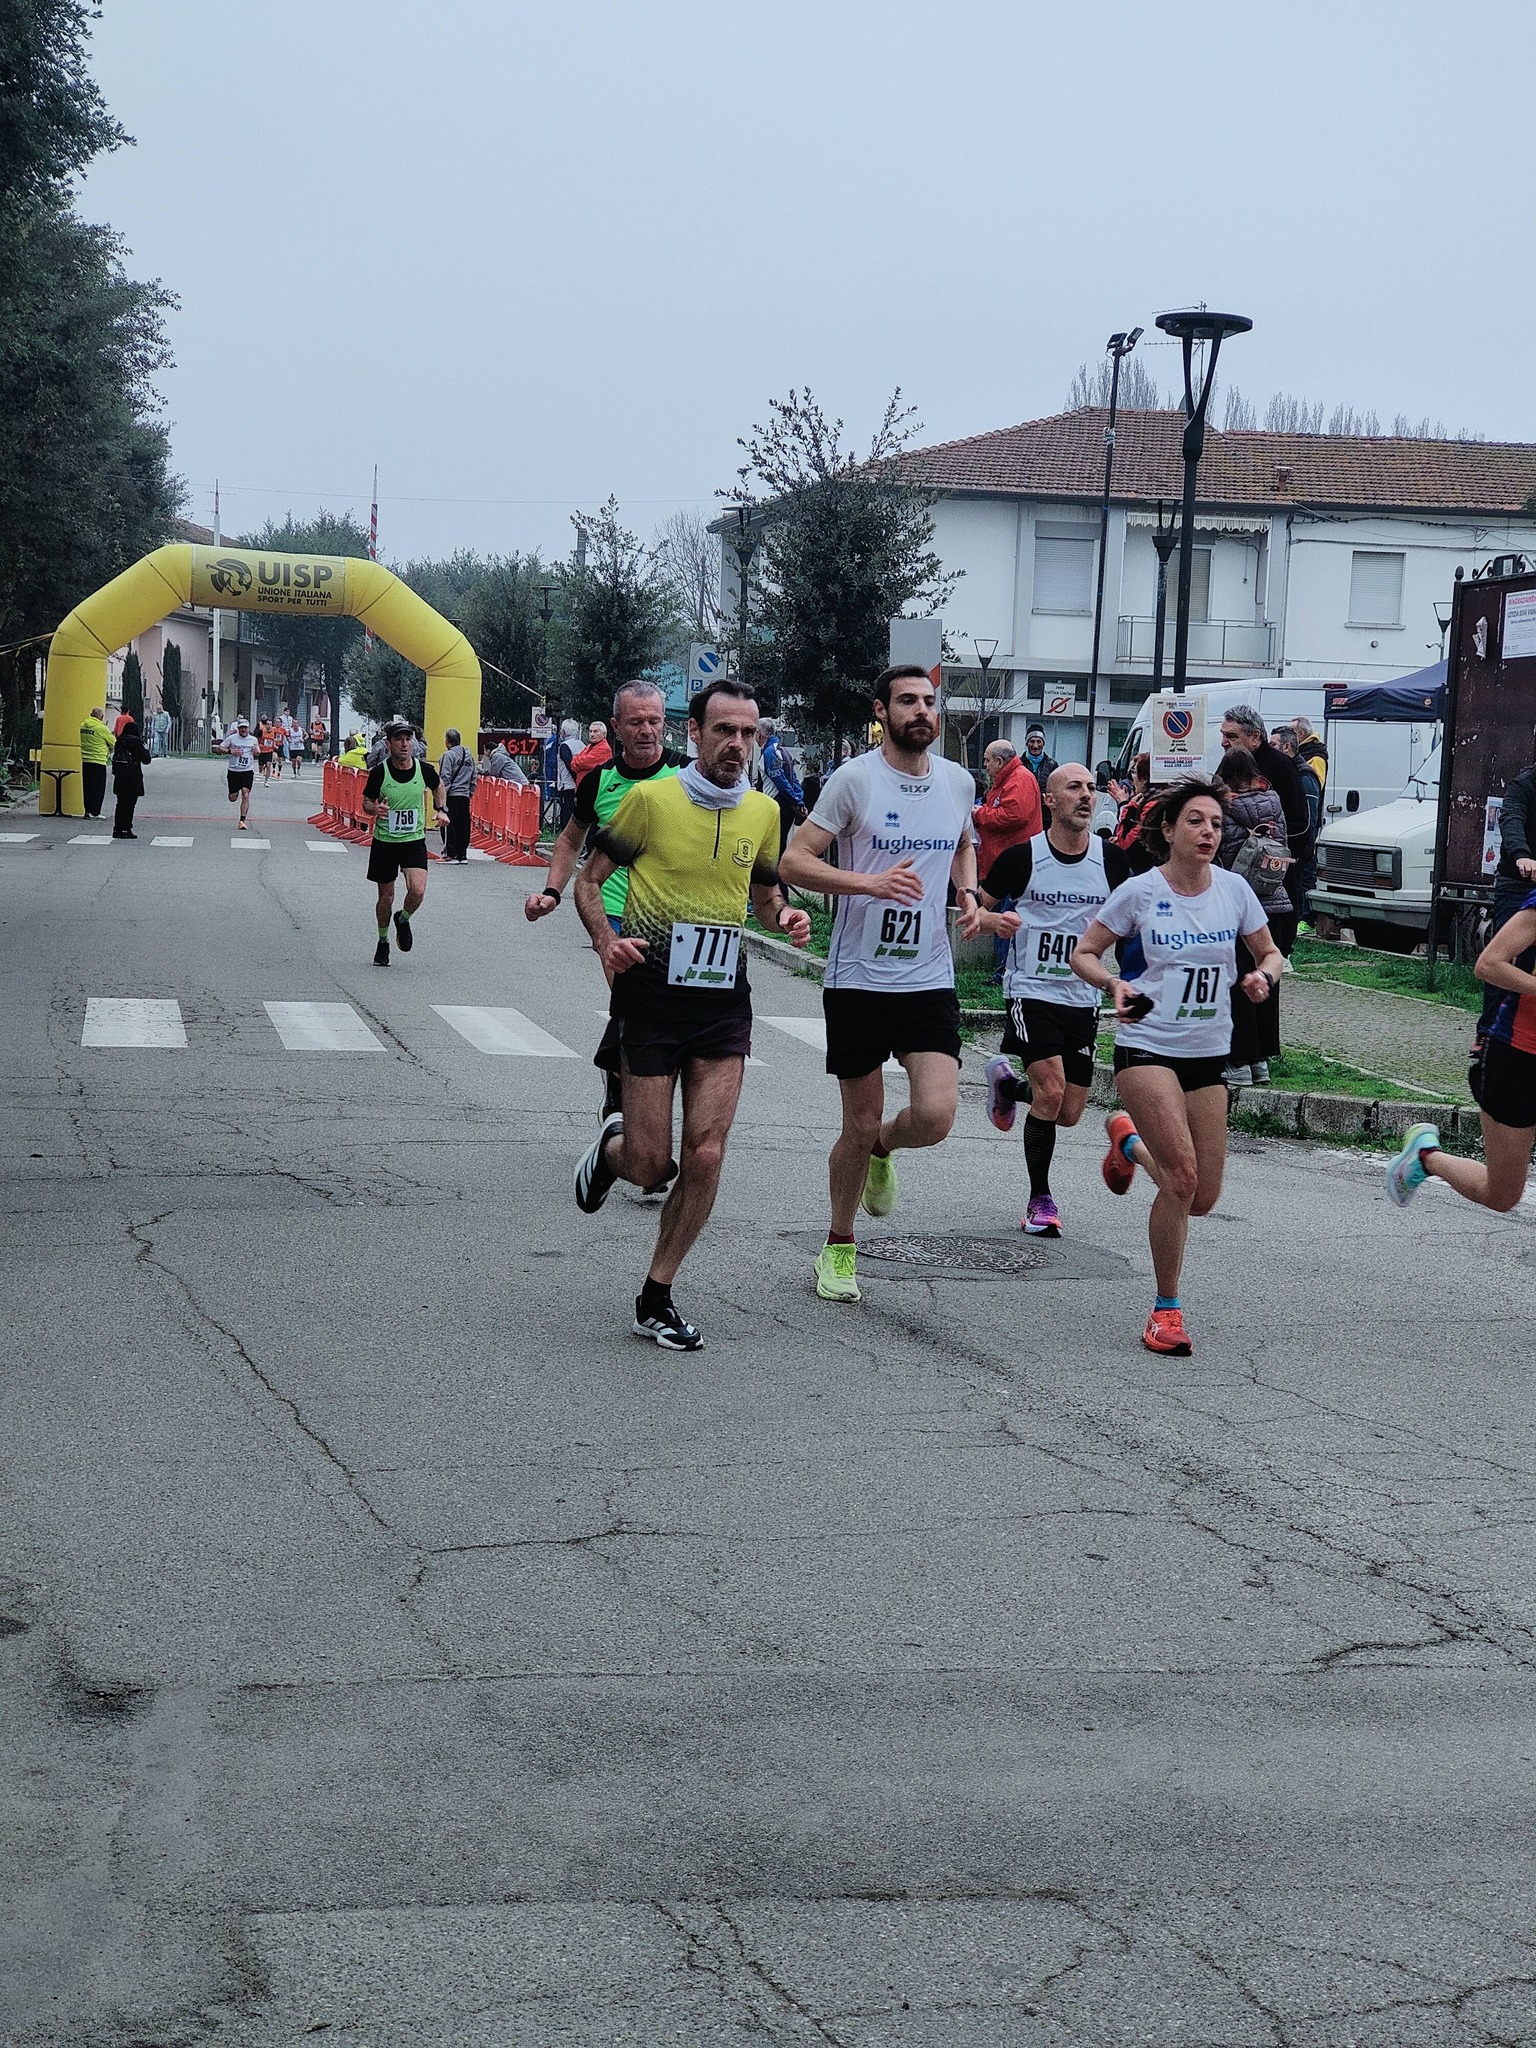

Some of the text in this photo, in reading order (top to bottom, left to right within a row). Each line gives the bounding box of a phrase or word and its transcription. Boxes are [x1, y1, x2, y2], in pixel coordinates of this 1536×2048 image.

[258, 561, 333, 589] UISP
[257, 586, 332, 600] UNIONE ITALIANA
[257, 594, 327, 607] SPORT PER TUTTI
[693, 680, 701, 690] P
[395, 810, 413, 825] 758
[871, 834, 955, 855] lughesina
[880, 908, 922, 945] 621
[692, 926, 732, 967] 777
[1037, 932, 1078, 964] 640
[1181, 966, 1220, 1004] 767
